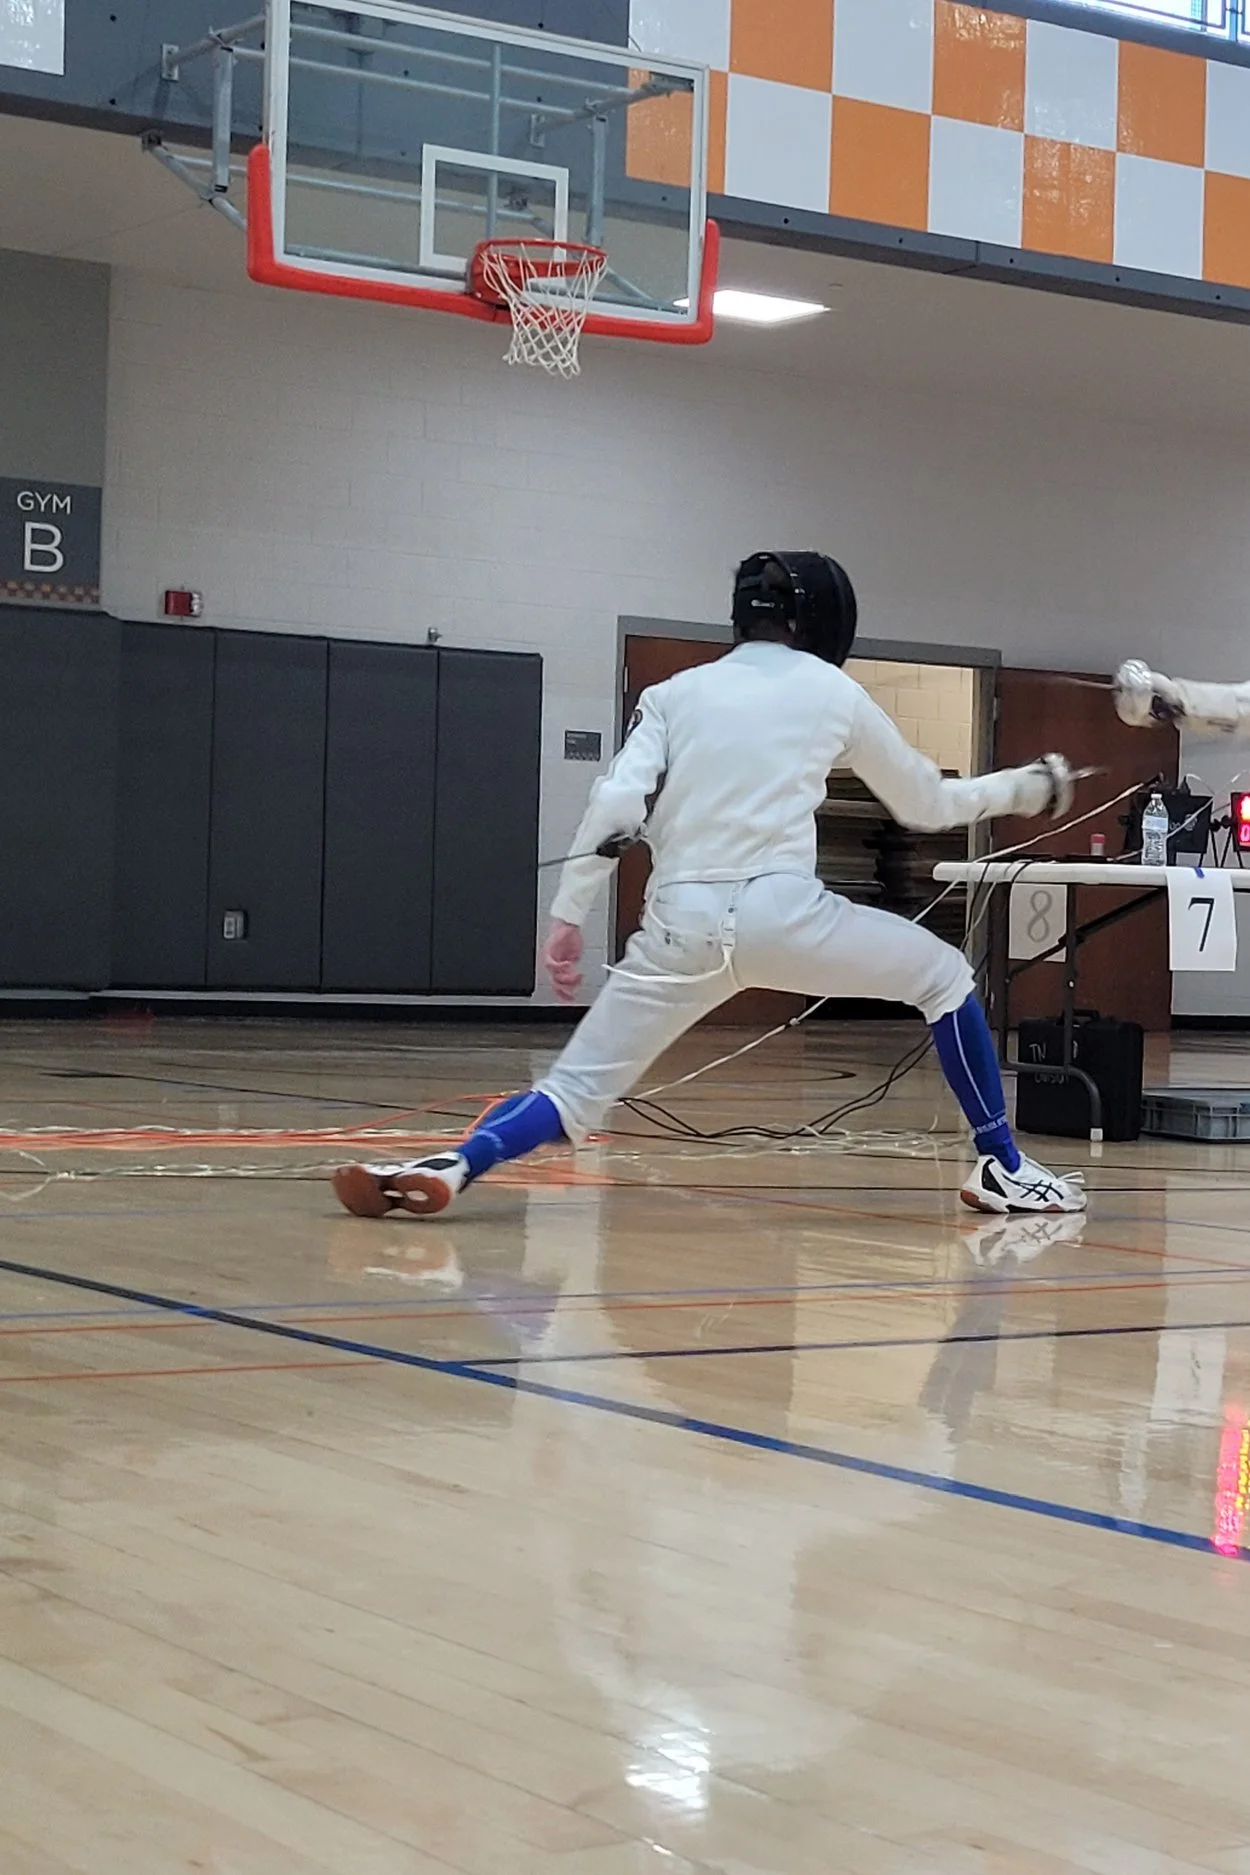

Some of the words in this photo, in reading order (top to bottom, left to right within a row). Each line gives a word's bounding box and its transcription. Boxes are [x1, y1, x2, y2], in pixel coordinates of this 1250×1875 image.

[17, 491, 71, 515] GYM
[24, 521, 64, 573] B
[1027, 890, 1053, 943] 8
[1187, 897, 1216, 952] 7
